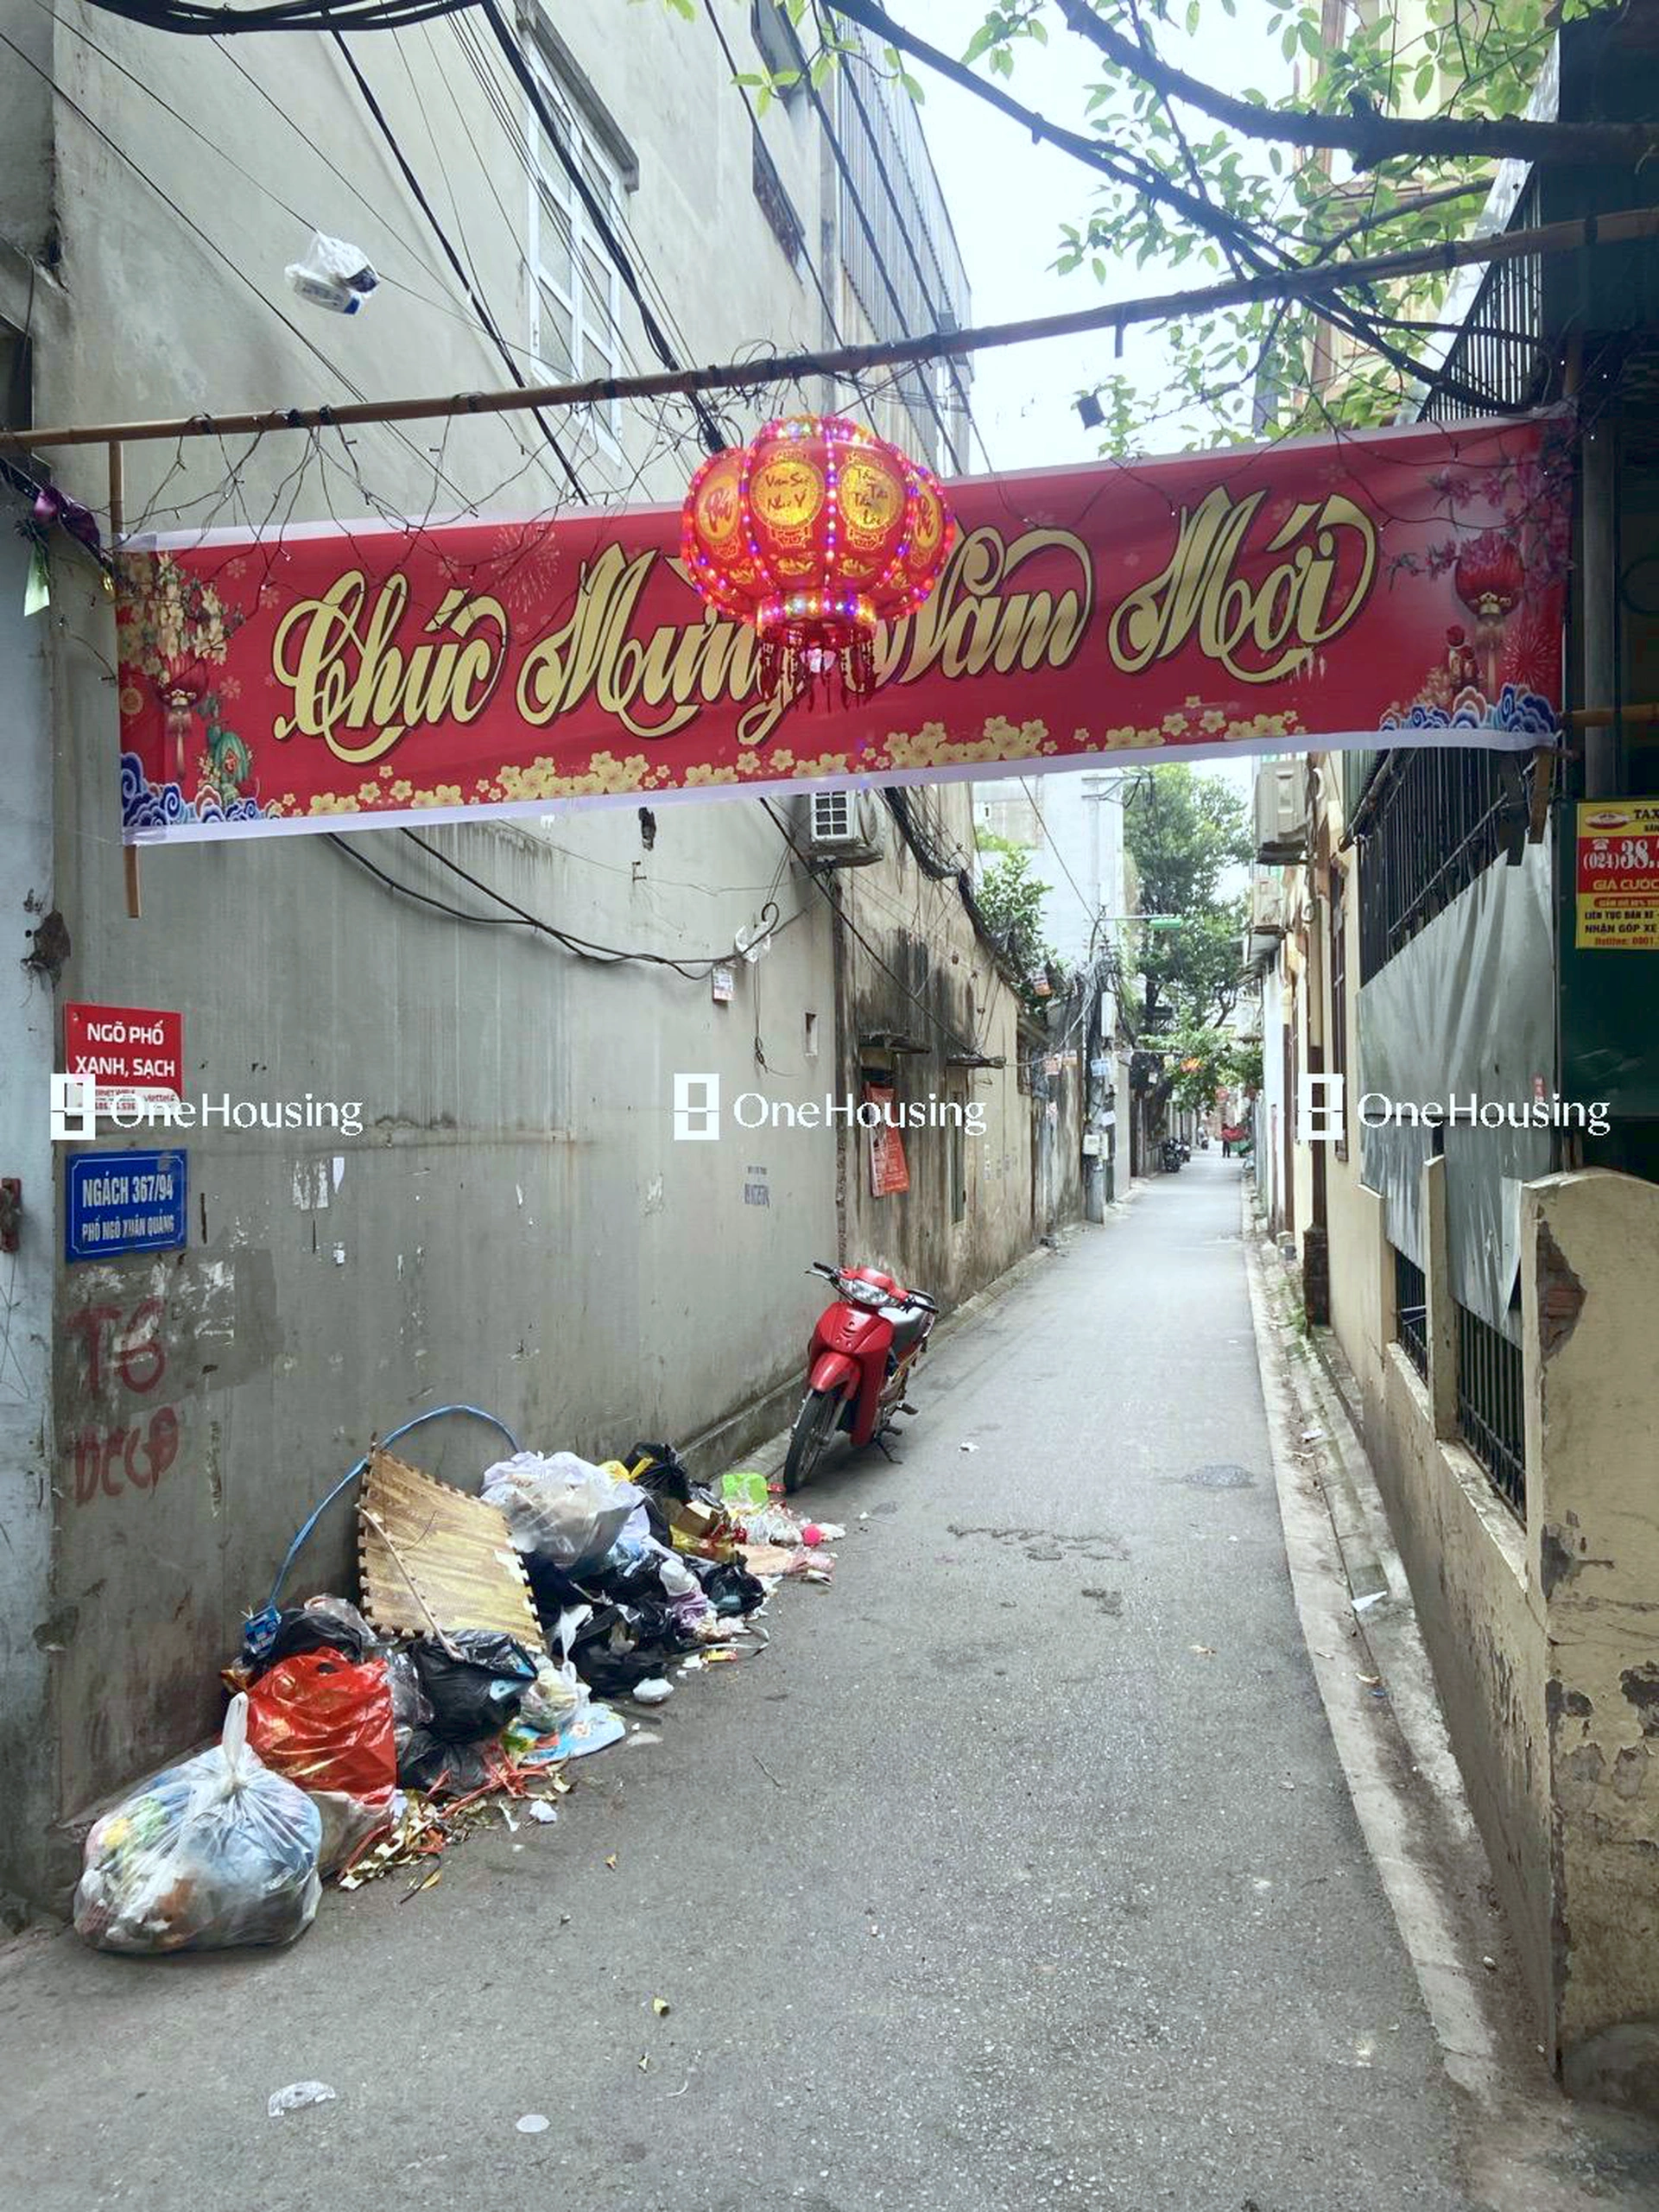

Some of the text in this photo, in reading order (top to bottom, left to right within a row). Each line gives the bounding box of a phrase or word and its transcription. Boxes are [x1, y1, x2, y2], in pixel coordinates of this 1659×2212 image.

[272, 569, 509, 764] Chúc
[1107, 485, 1379, 683] Mới
[87, 1020, 164, 1045] NGÕ PHỐ
[75, 1055, 175, 1080] XANH, SẠCH
[82, 1170, 174, 1208] NGÁCH 367/94
[82, 1214, 101, 1244] PHỐ
